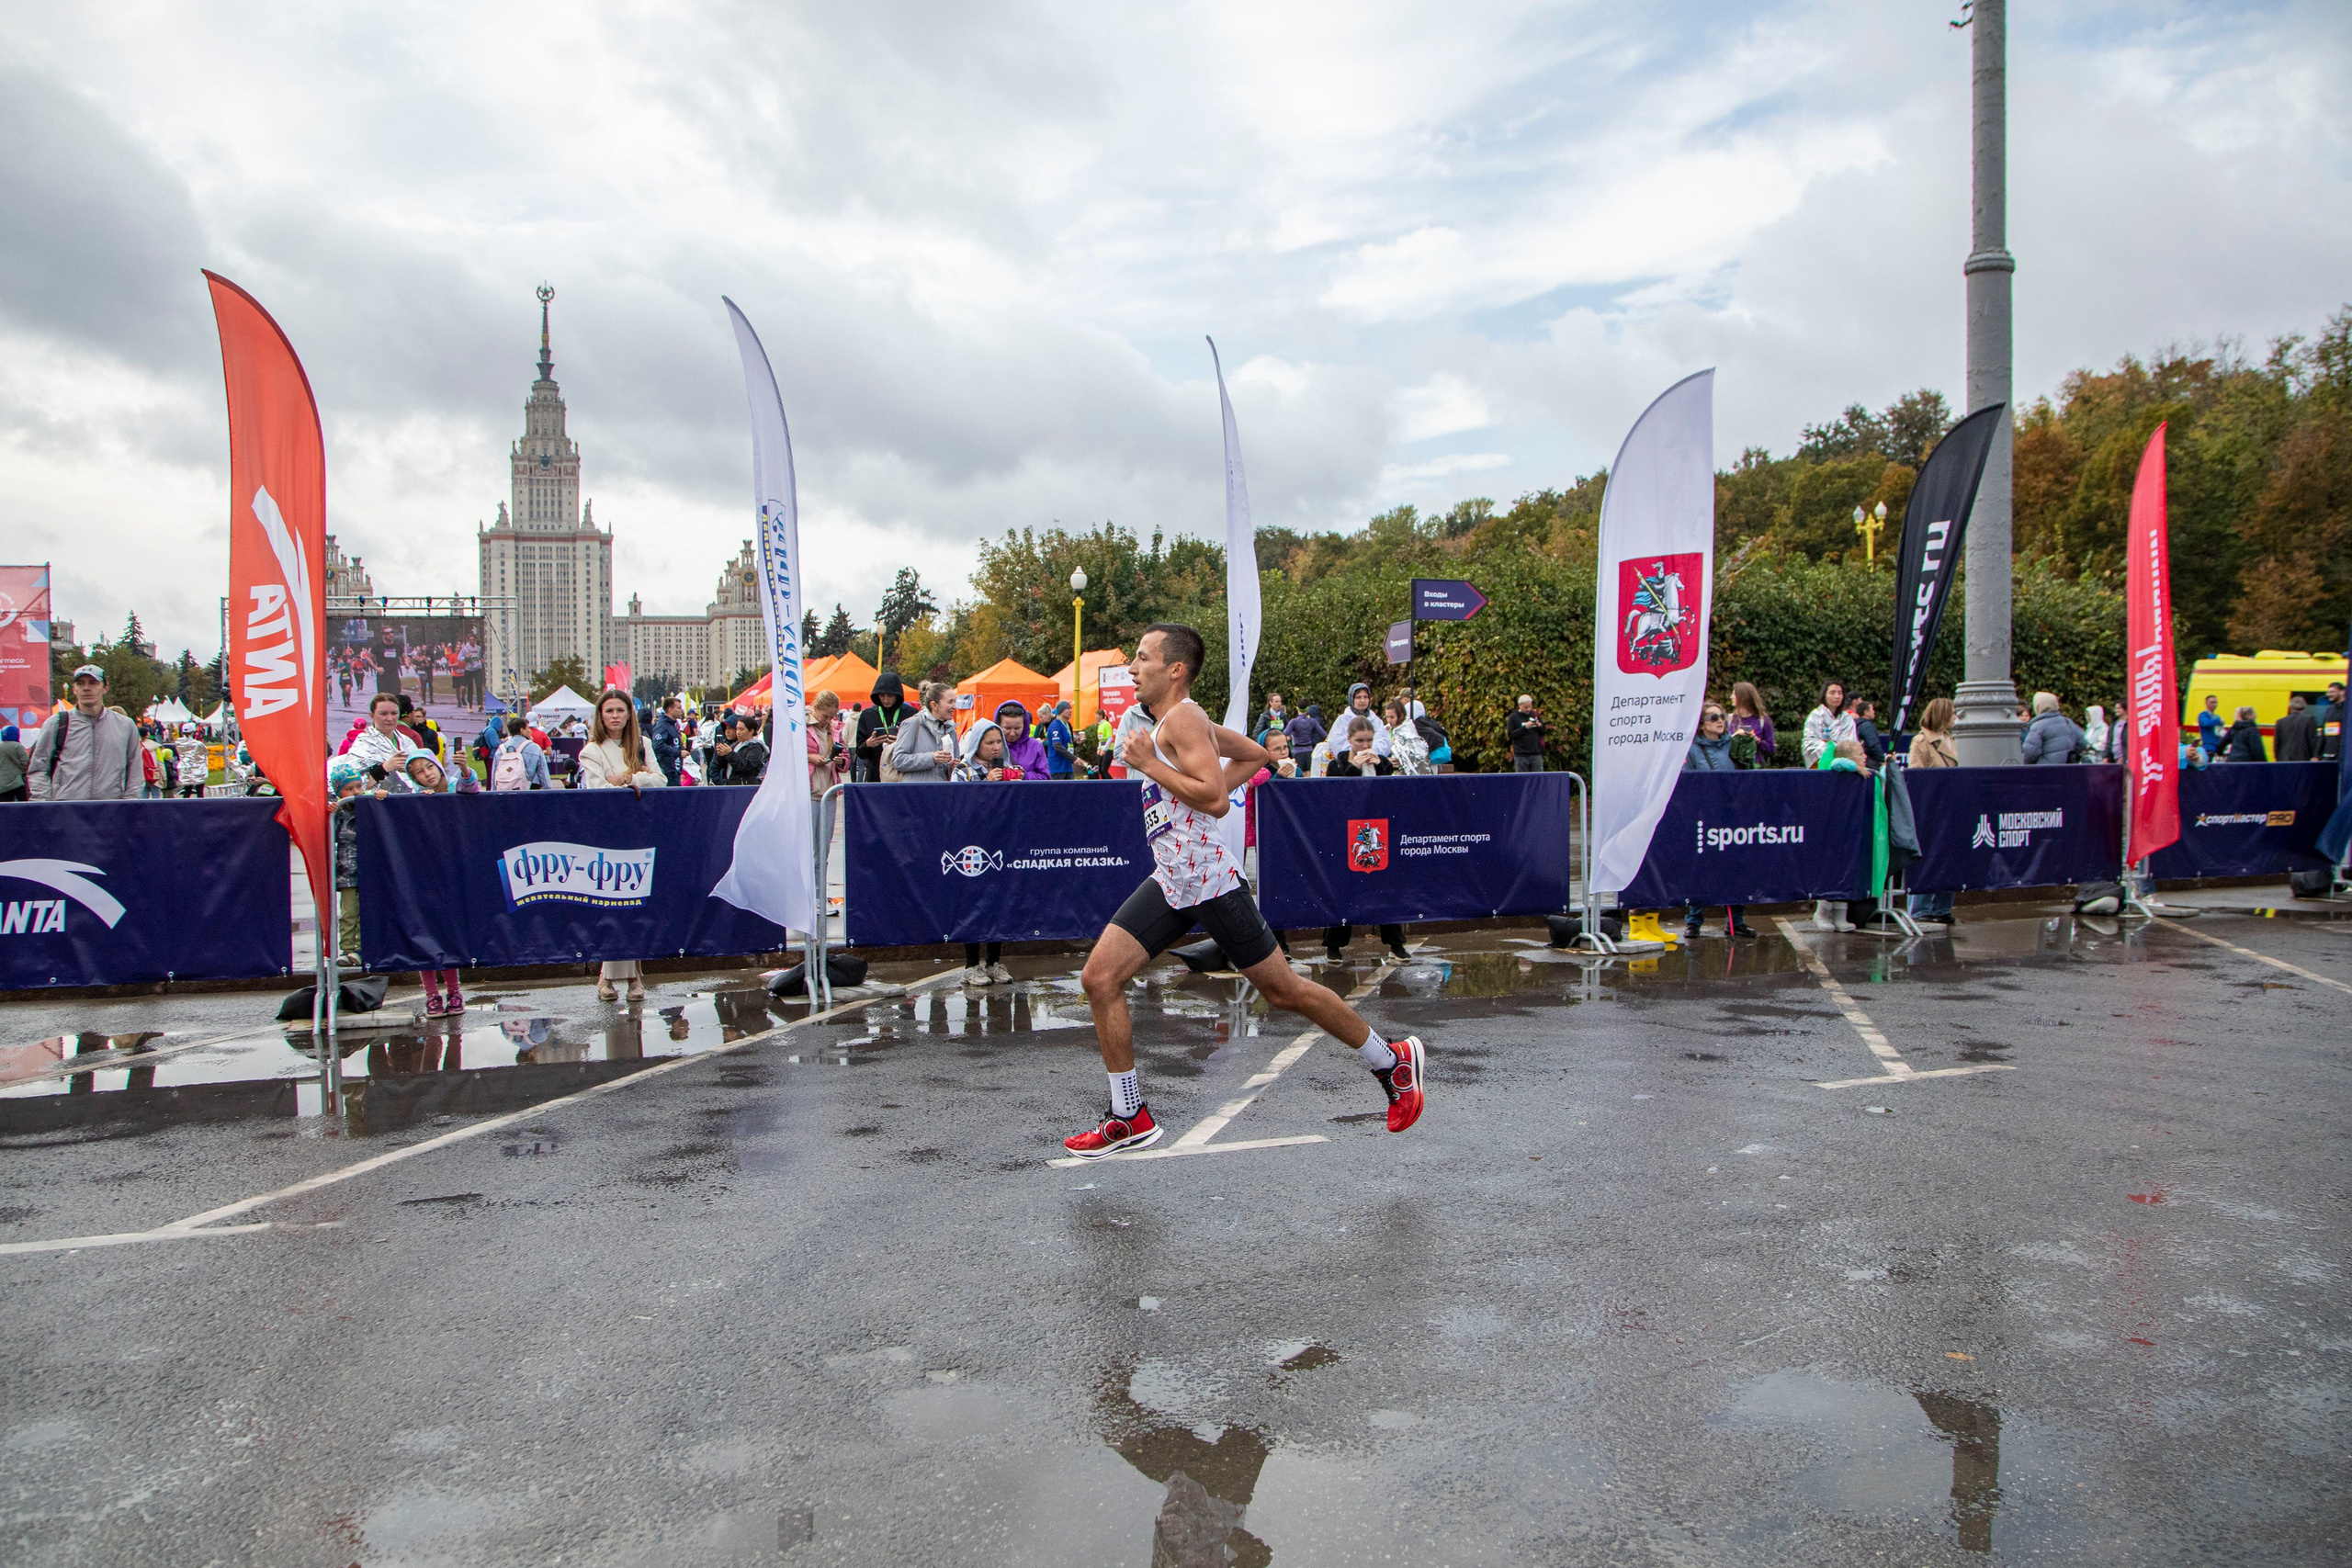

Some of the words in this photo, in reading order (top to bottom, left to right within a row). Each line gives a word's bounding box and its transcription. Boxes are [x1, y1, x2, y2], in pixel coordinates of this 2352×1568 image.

[1610, 715, 1651, 727] спорта
[1609, 733, 1649, 746] города
[1653, 730, 1687, 742] Москв
[1998, 807, 2063, 830] МОСКОВСКИЙ
[2205, 813, 2267, 825] спортмастер
[2267, 812, 2294, 824] PRO
[1400, 835, 1459, 845] Департамент
[1460, 834, 1490, 843] спорта
[1706, 822, 1804, 851] sports.ru
[1998, 829, 2030, 848] СПОРТ
[1030, 847, 1061, 856] группа
[1063, 846, 1108, 854] компаний
[1400, 847, 1431, 857] города
[1433, 845, 1468, 854] Москвы
[514, 848, 650, 891] фру-фру
[1006, 859, 1071, 870] «СЛАДКАЯ
[1074, 857, 1130, 867] СКАЗКА»
[515, 893, 589, 907] жевательный
[591, 898, 642, 907] мармелад
[0, 900, 65, 934] NTA
